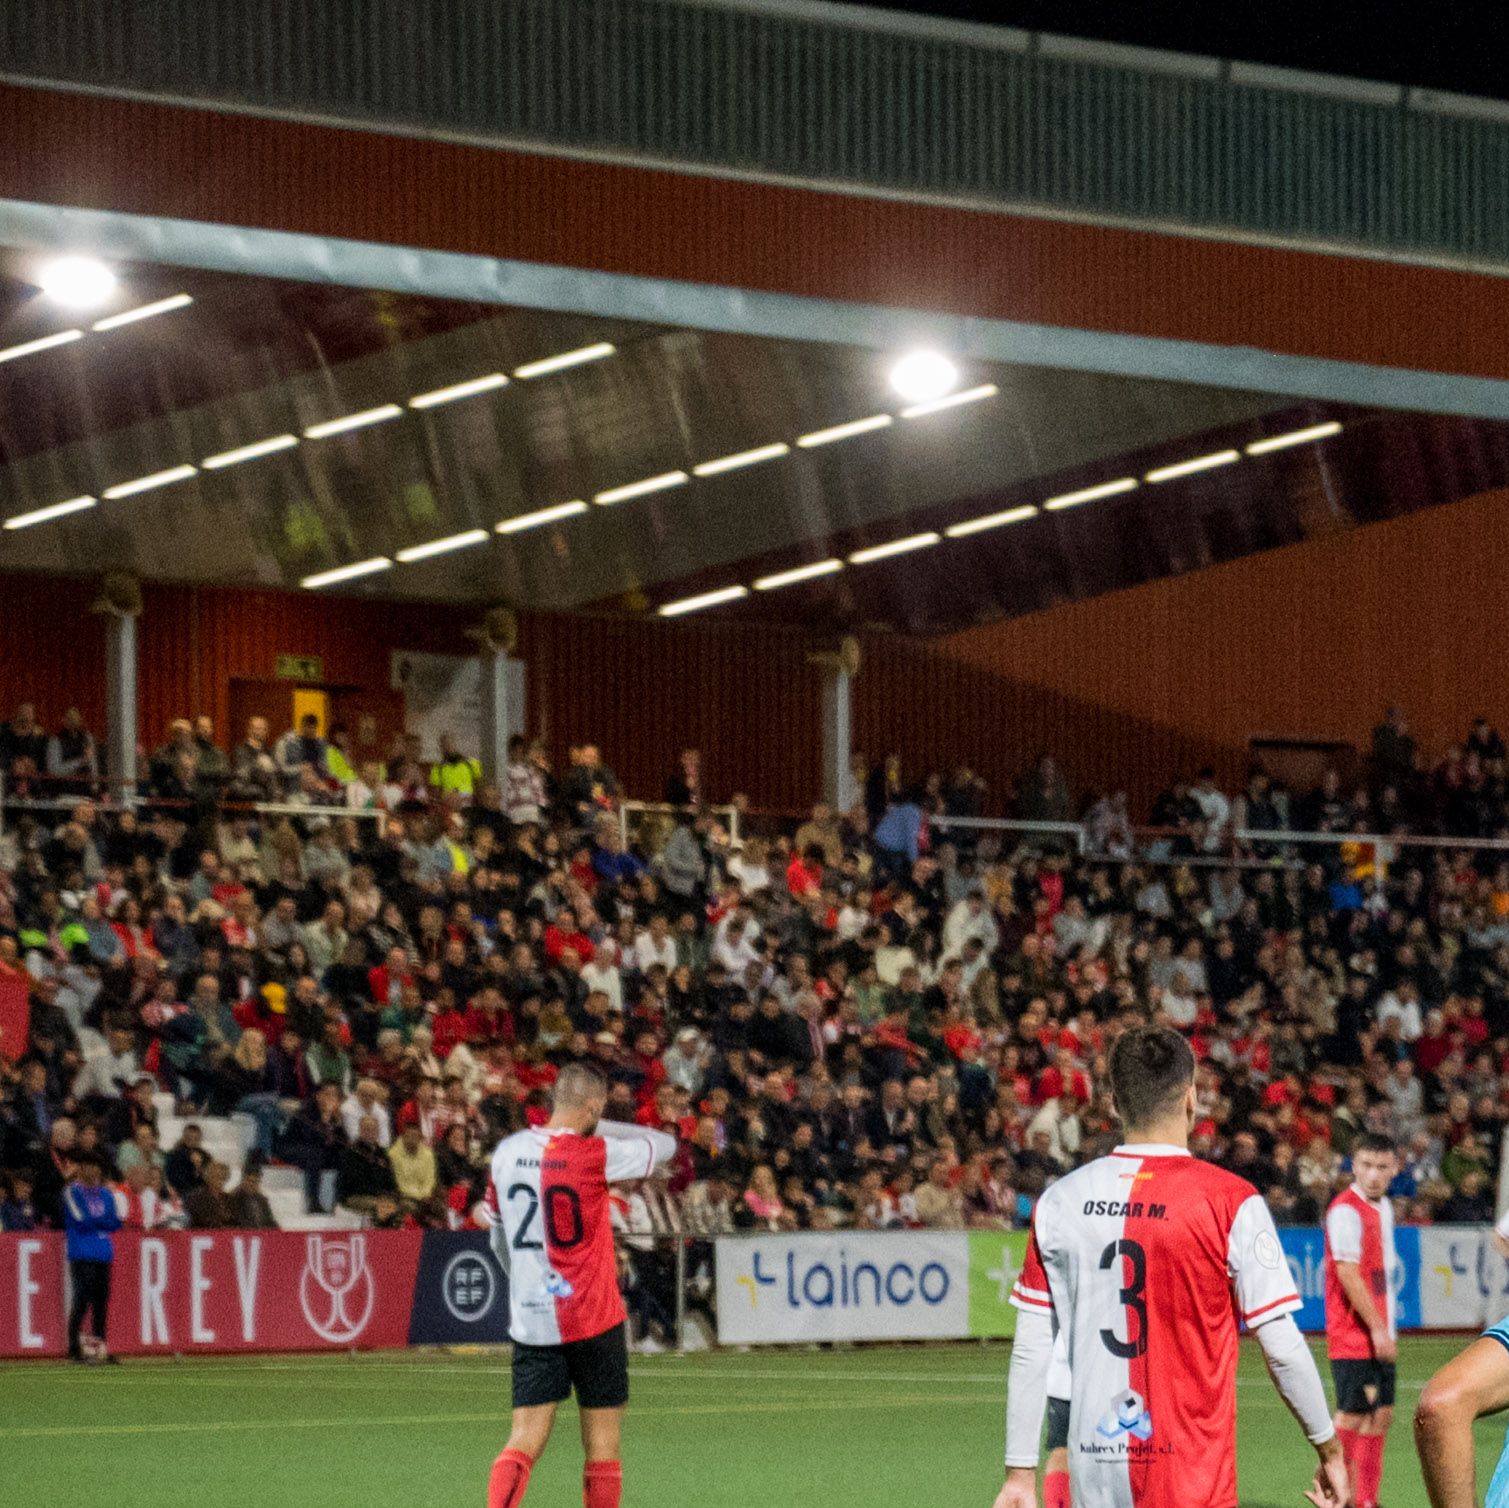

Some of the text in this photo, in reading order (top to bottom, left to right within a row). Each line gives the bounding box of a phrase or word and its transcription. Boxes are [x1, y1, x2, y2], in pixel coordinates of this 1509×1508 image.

[507, 1182, 584, 1250] 20
[1083, 1200, 1143, 1218] OSCAR
[140, 1236, 262, 1345] REY
[786, 1250, 950, 1308] lainco
[1099, 1239, 1148, 1359] 3
